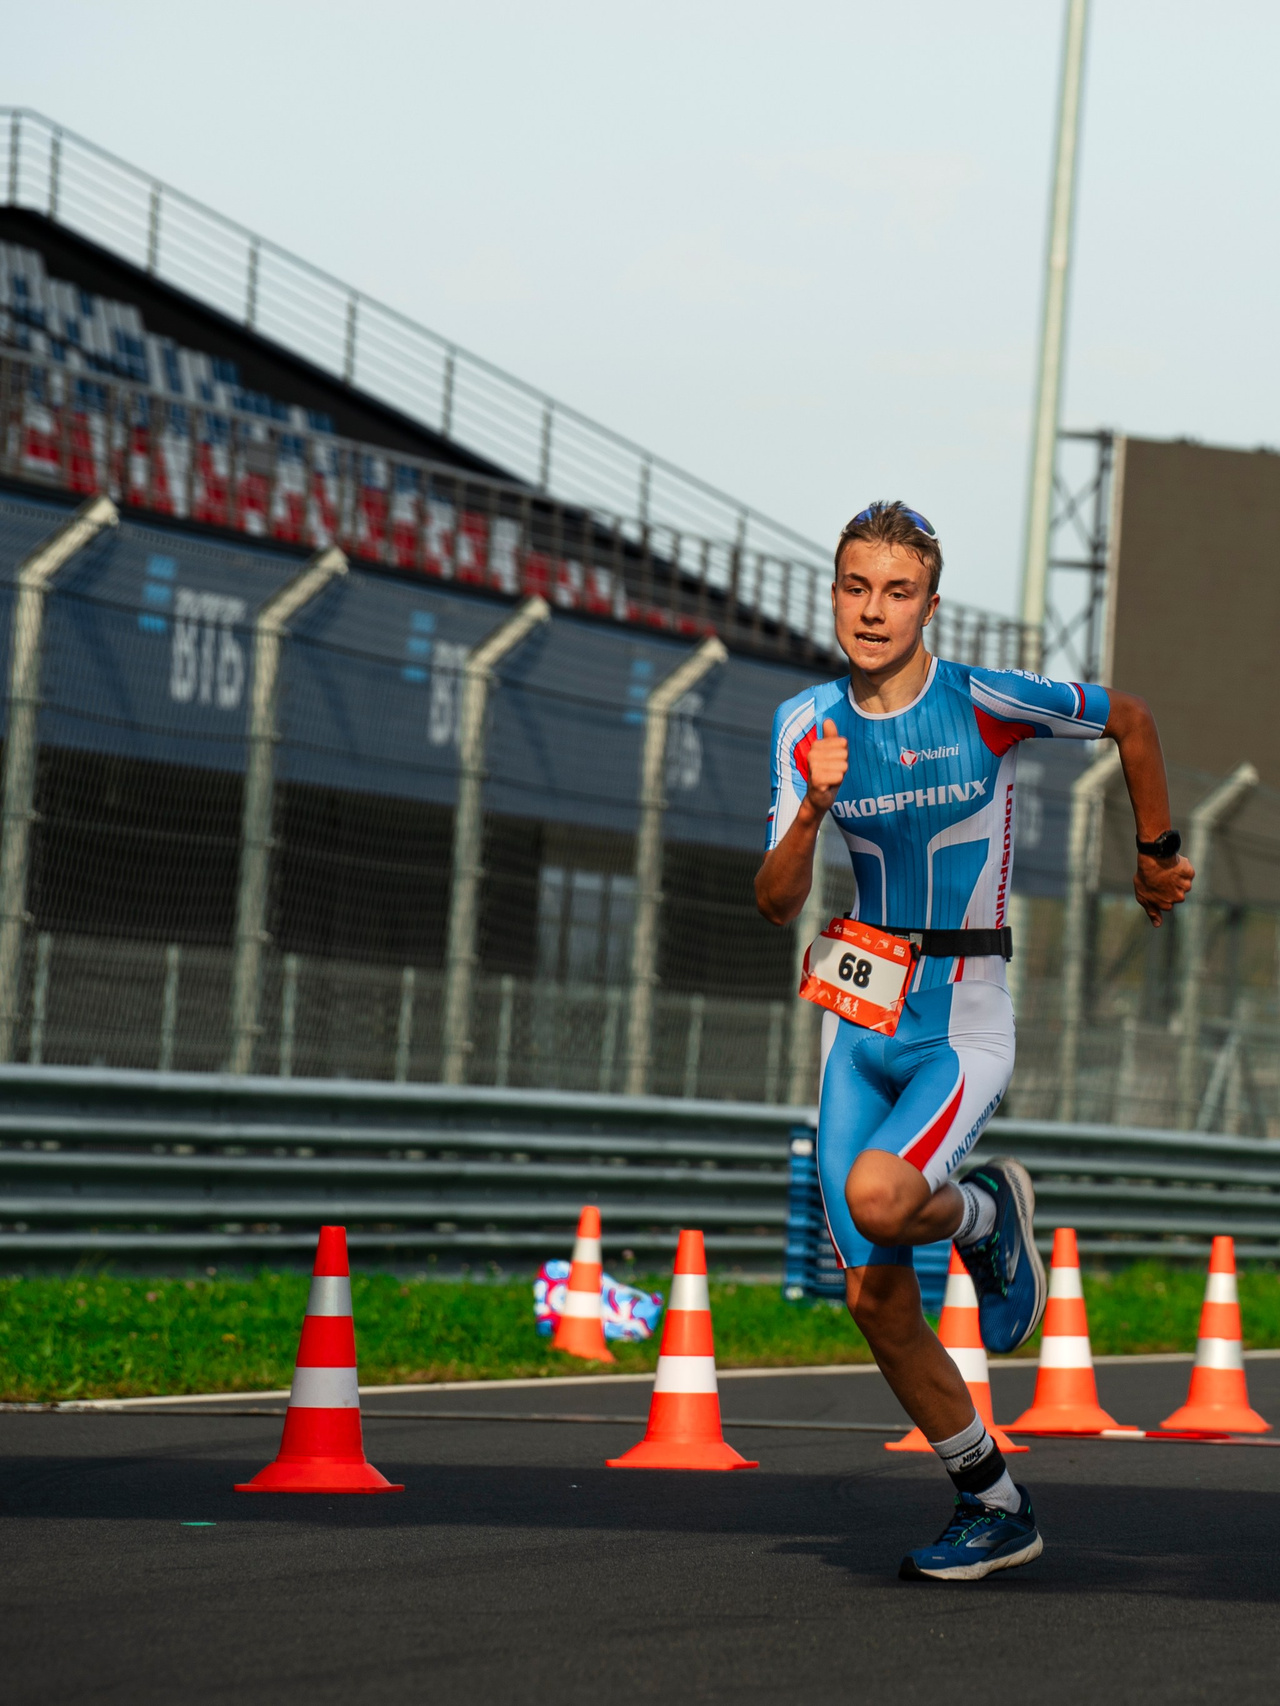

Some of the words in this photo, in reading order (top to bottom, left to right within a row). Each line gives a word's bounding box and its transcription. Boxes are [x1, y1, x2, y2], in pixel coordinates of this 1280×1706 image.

[919, 744, 960, 762] Nalini
[832, 777, 989, 818] OKOSPHINX
[995, 784, 1014, 929] LOKOSPHIN
[838, 952, 873, 989] 68
[962, 1447, 981, 1465] NIKE
